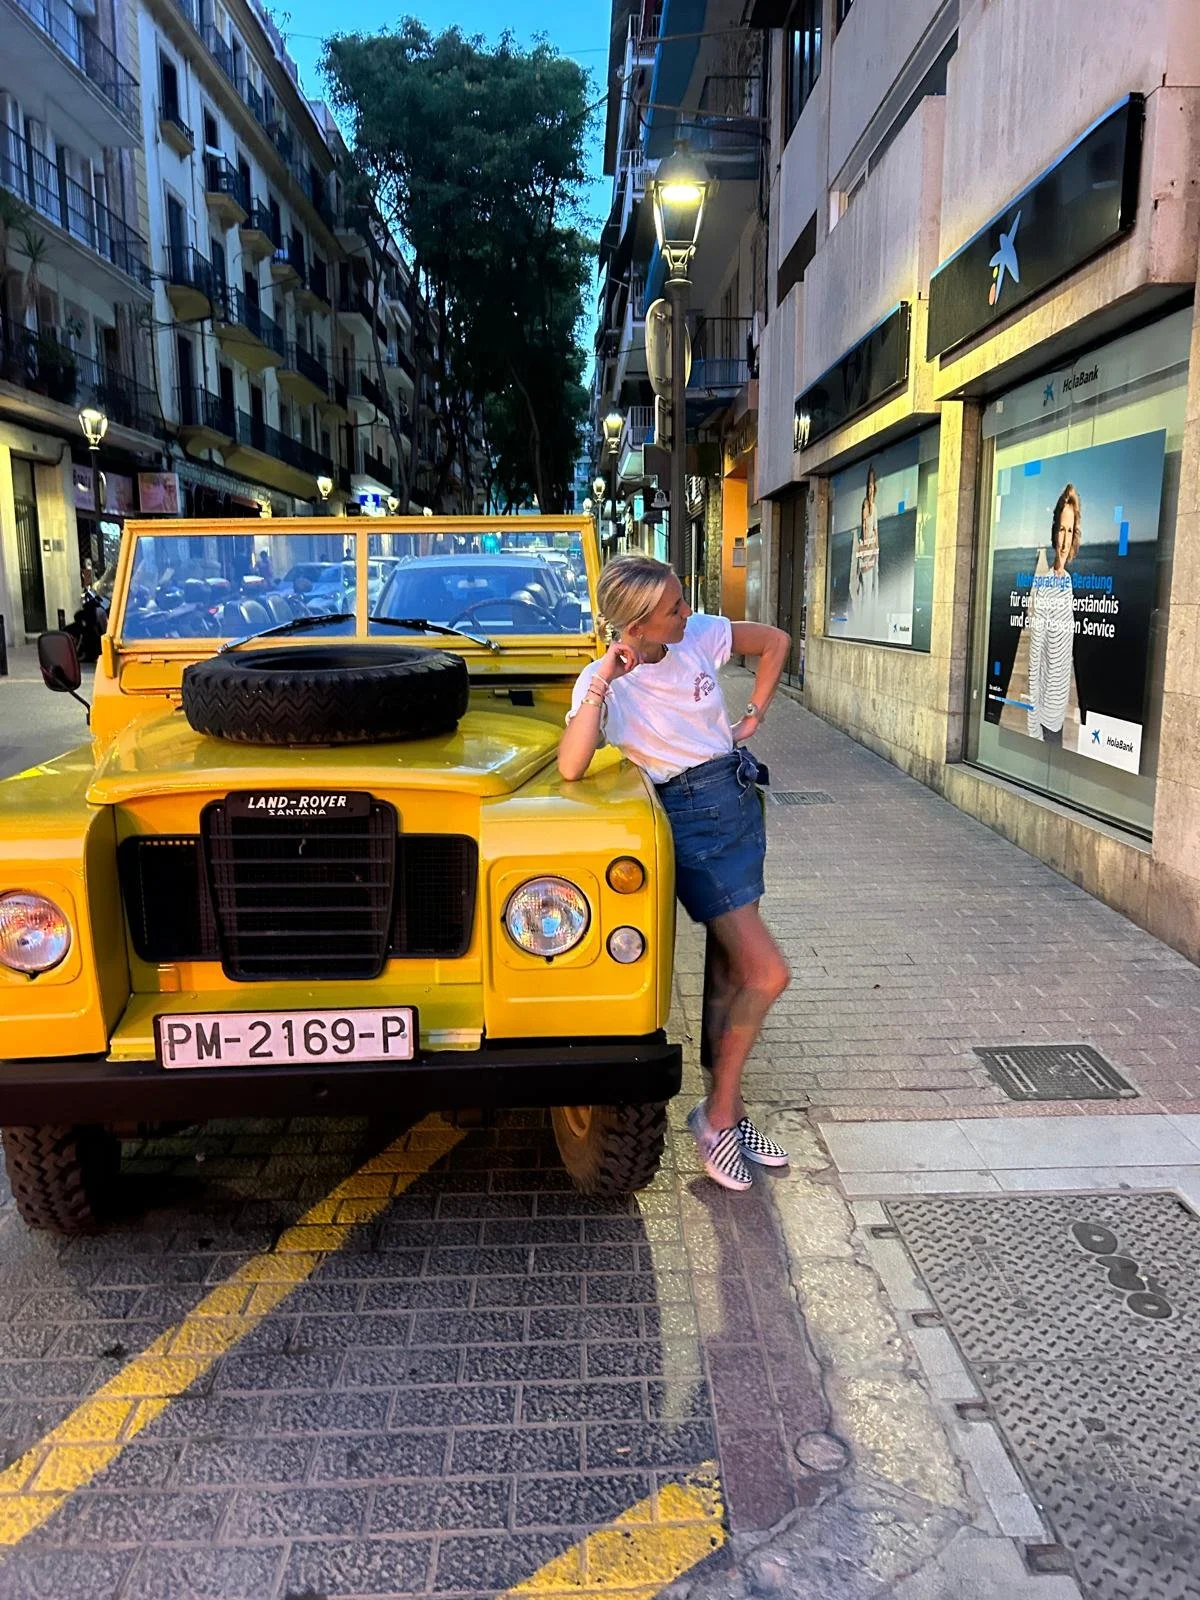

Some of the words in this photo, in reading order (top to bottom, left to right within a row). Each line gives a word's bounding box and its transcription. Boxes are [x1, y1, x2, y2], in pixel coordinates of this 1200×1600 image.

[1062, 364, 1099, 393] HolaBank
[1016, 572, 1070, 591] Mehrsprachige
[1072, 572, 1113, 594] Beratung
[1010, 591, 1021, 607] für
[1021, 591, 1033, 607] ein
[1010, 611, 1024, 627] und
[1082, 618, 1115, 638] Service
[1106, 735, 1134, 752] HolaBank
[248, 795, 347, 809] LAND-ROVER
[268, 808, 327, 816] SANTANA
[166, 1015, 407, 1061] PM-2169-P
